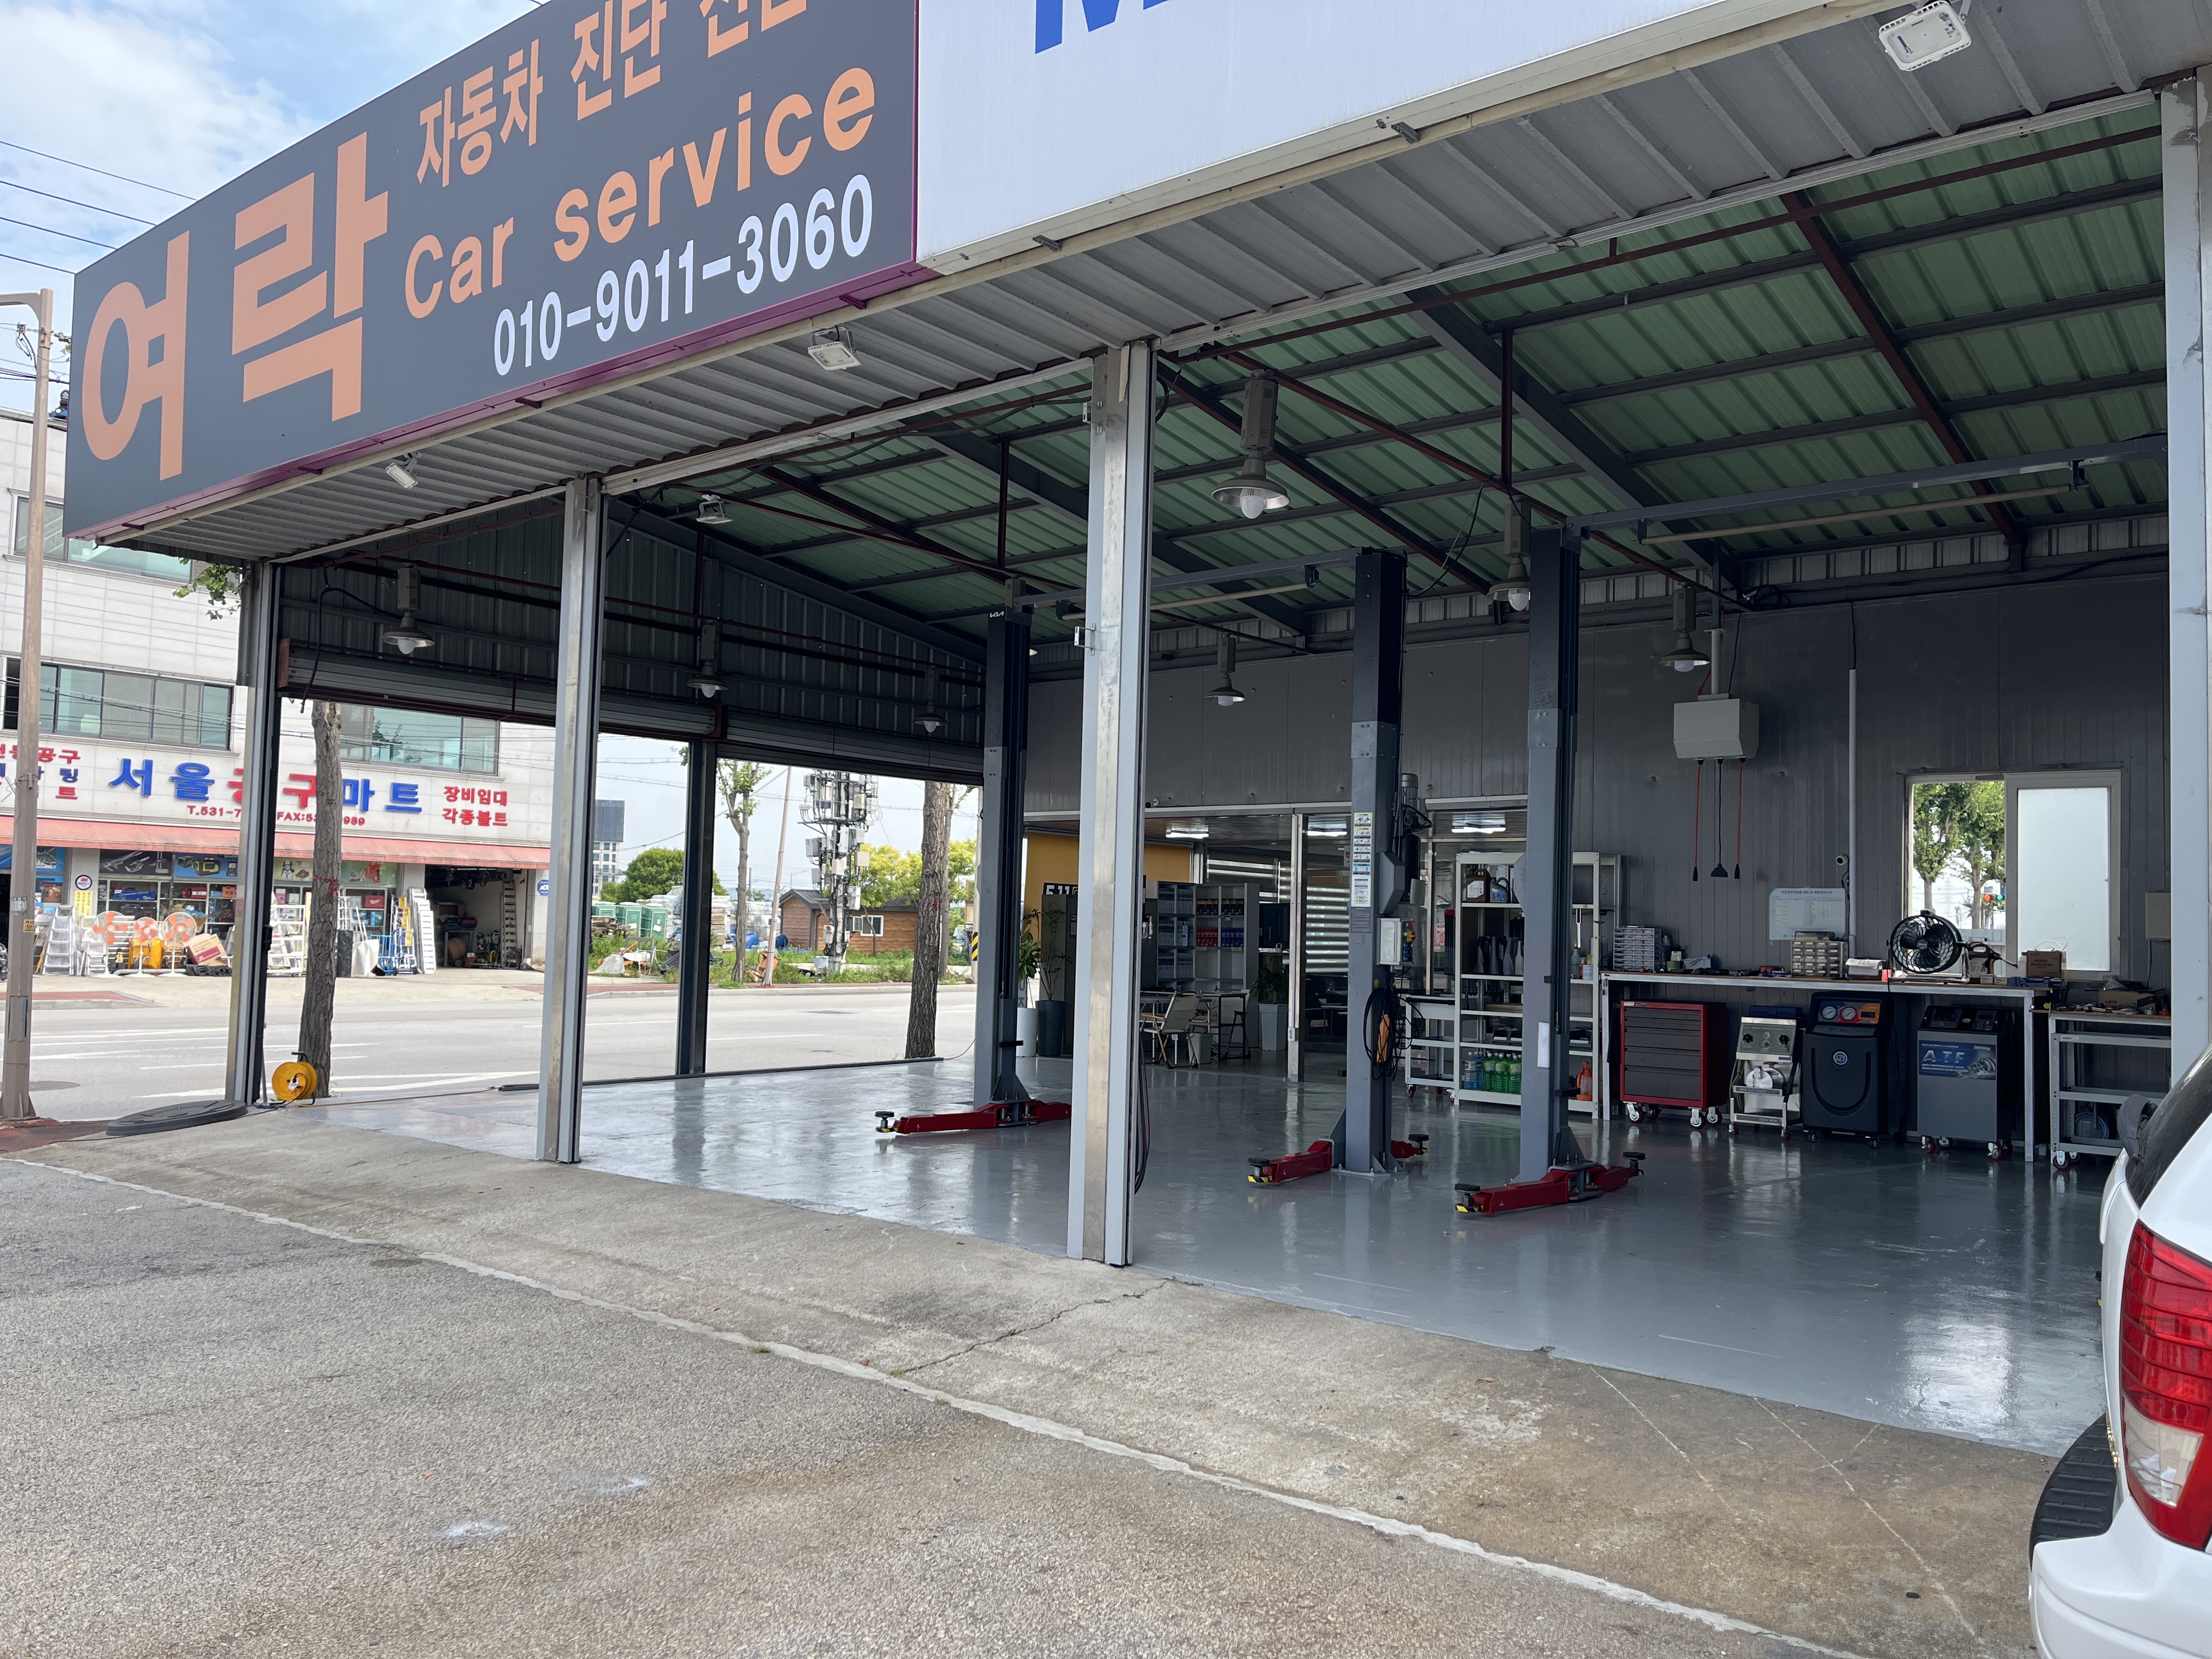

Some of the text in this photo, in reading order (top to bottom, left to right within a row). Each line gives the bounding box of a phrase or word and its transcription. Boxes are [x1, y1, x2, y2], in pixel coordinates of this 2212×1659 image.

[417, 38, 543, 188] 자동차
[571, 0, 667, 121] 진단
[405, 67, 876, 318] Car service
[494, 174, 873, 375] 010-9011-3060
[83, 132, 388, 481] 여락
[187, 805, 242, 817] T.531-7
[442, 808, 508, 827] 각종볼트
[444, 786, 507, 806] 장비임대
